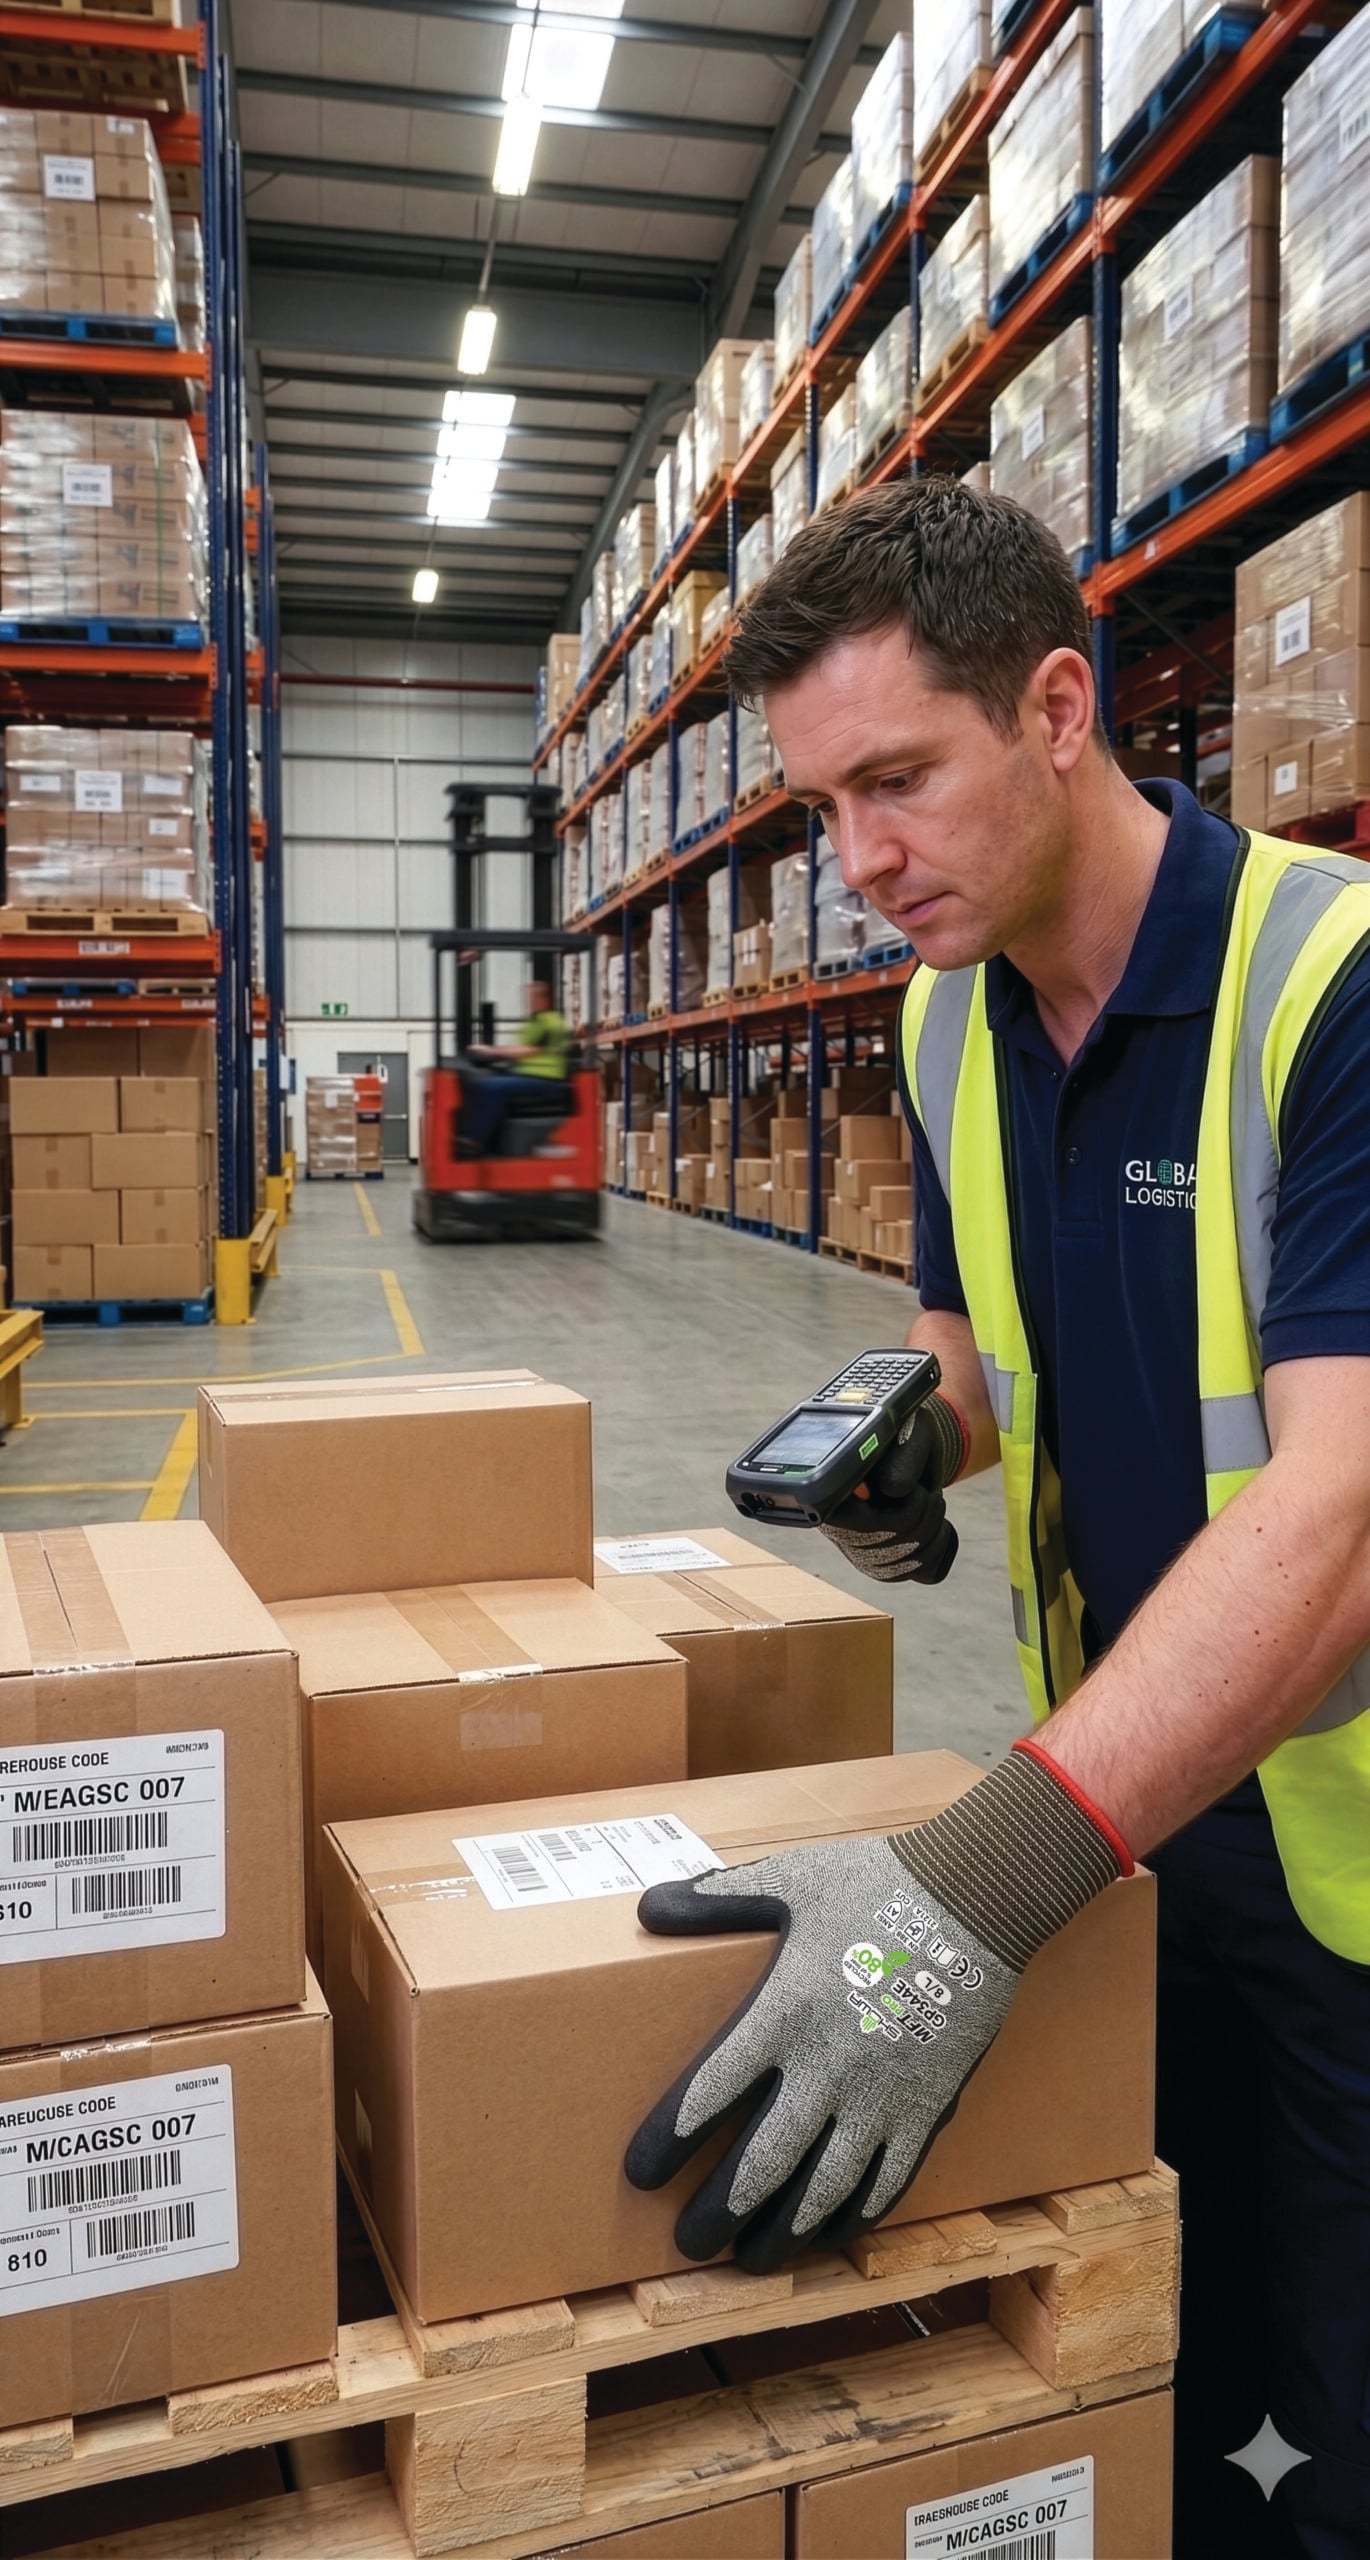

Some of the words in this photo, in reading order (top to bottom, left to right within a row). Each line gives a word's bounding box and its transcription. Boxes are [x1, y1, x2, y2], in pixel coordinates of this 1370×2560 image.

[140, 1776, 186, 1801] 007
[892, 1979, 945, 2028] GP344E
[925, 1976, 944, 1999] 8/L
[26, 2123, 142, 2164] M/CAGSC
[152, 2113, 197, 2140] 007
[7, 2248, 48, 2272] 810
[946, 2511, 1029, 2551] M/CAGSC
[1035, 2499, 1068, 2524] 007
